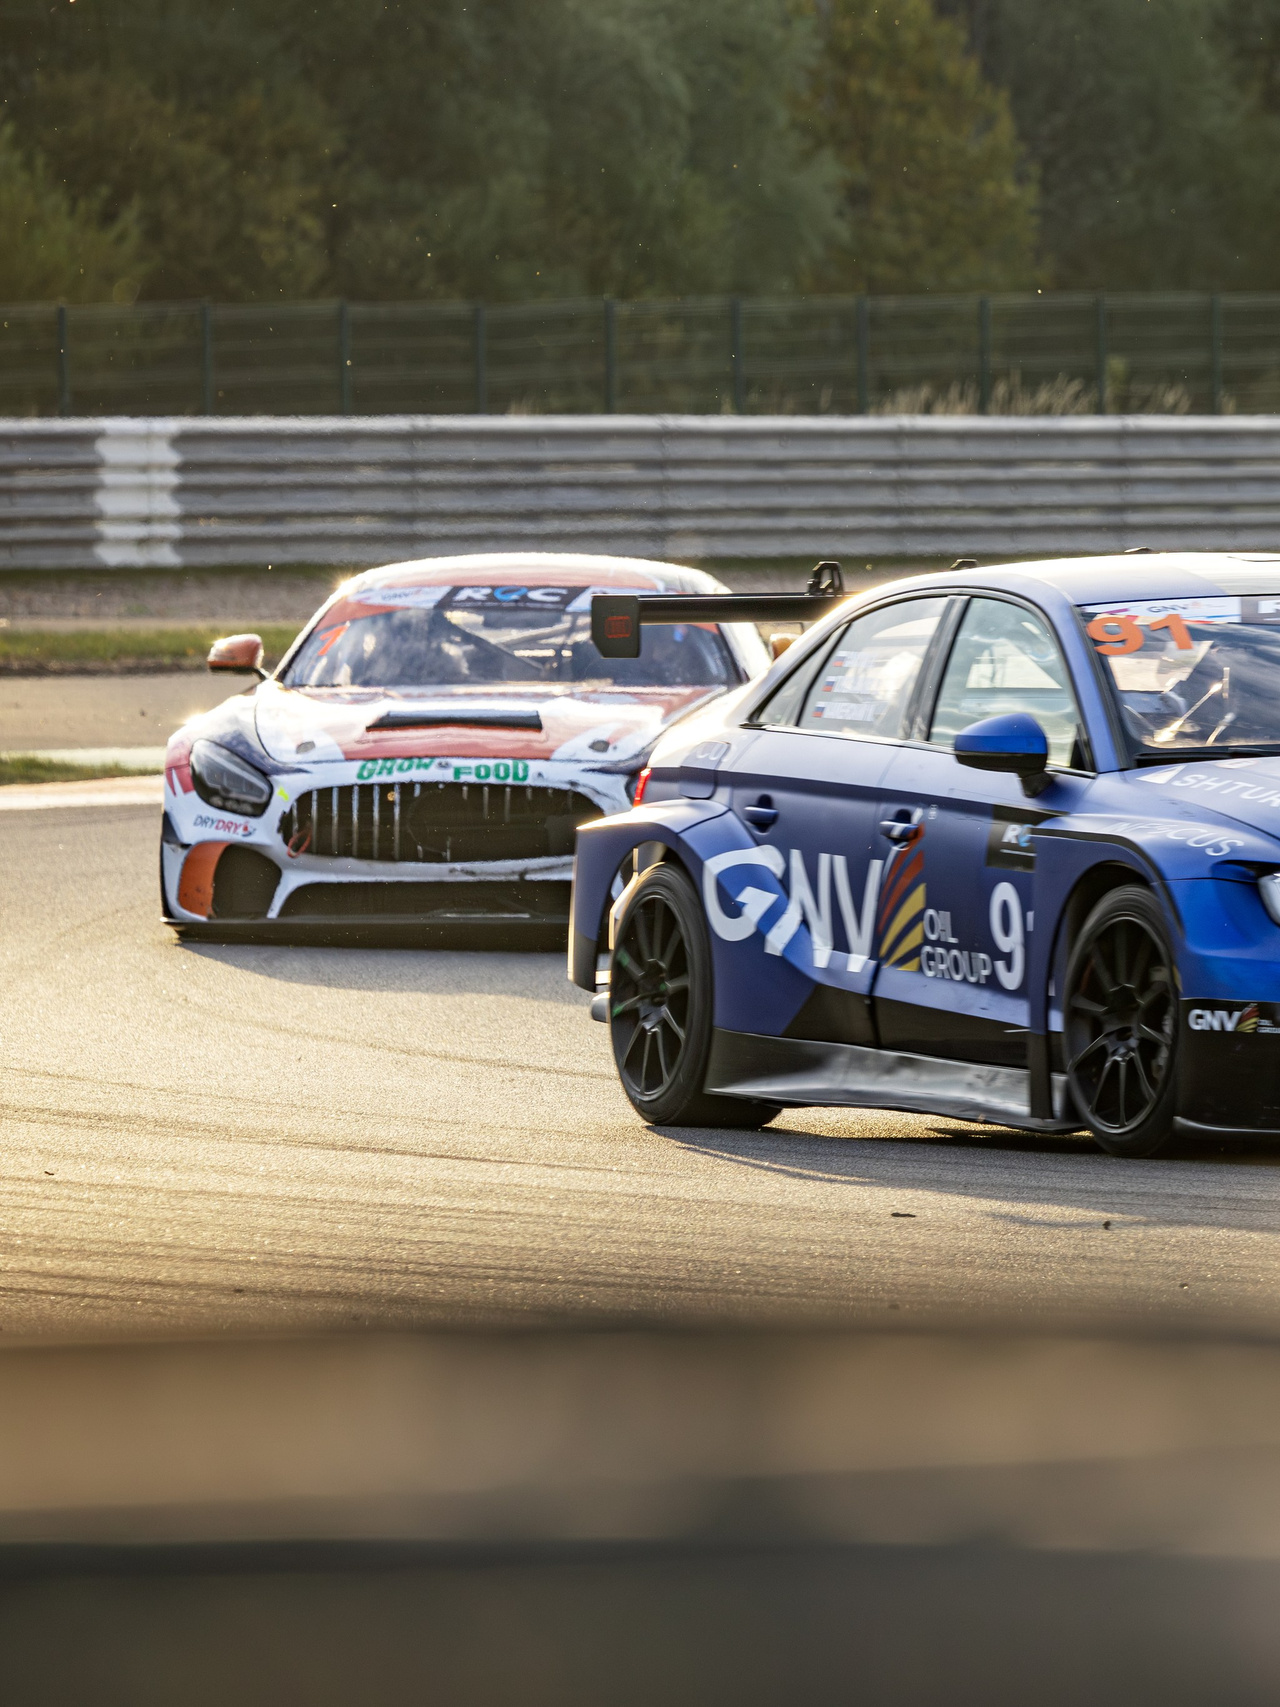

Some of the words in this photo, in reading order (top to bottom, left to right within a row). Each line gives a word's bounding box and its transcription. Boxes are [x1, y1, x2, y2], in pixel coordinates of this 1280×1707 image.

[1086, 613, 1194, 656] 91
[453, 760, 529, 782] FOOD
[703, 844, 883, 973] GNV
[923, 908, 958, 944] OIL
[920, 945, 993, 984] GROUP
[1188, 1008, 1243, 1032] GNV
